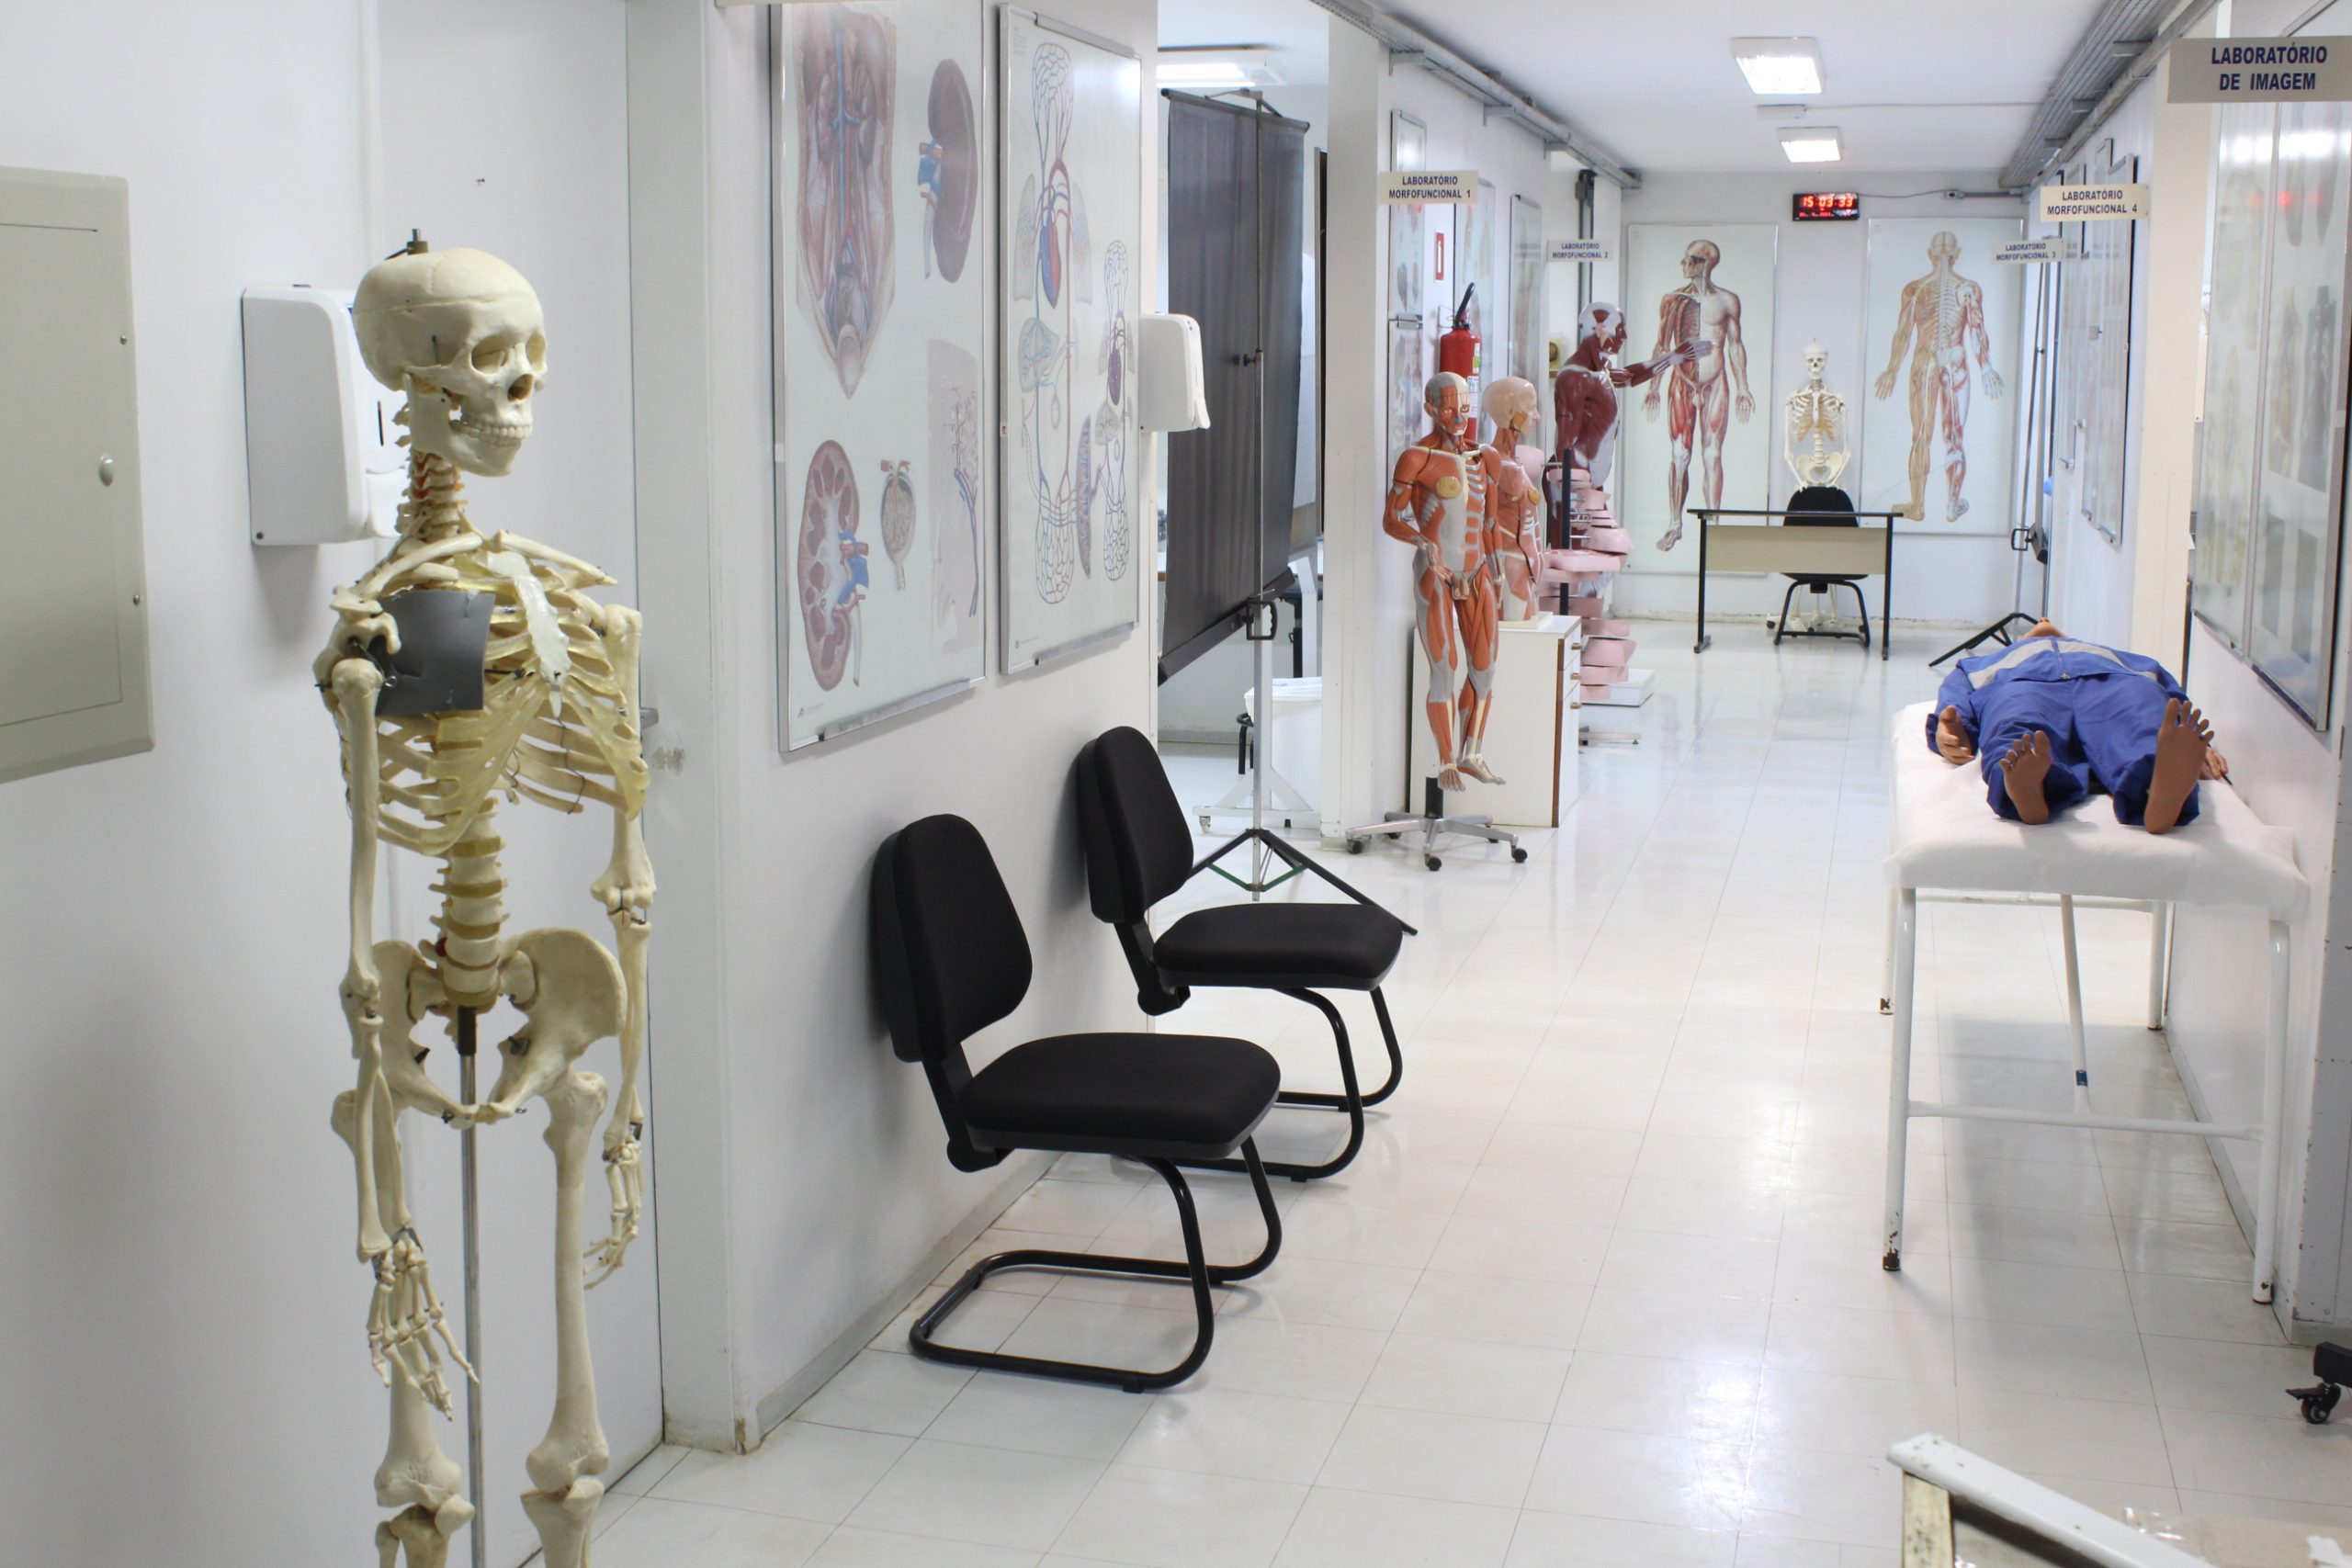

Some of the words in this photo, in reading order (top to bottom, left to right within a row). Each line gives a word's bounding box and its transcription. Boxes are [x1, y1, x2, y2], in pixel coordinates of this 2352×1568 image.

[2211, 42, 2327, 64] LABORATÓRIO
[2220, 73, 2241, 91] DE
[2250, 73, 2316, 91] IMAGEM
[1402, 174, 1458, 186] LABORATÓRIO
[1388, 188, 1462, 199] MORFOFUNCIONAL
[1466, 189, 1471, 198] 1
[2062, 188, 2123, 201] LABORATÓRIO
[2047, 204, 2128, 215] MORFOFUNCIONAL
[2132, 204, 2138, 213] 4
[1552, 251, 1602, 259] MORFOFUNCIONAL
[1996, 252, 2049, 261] MORFOFUNCIONAL
